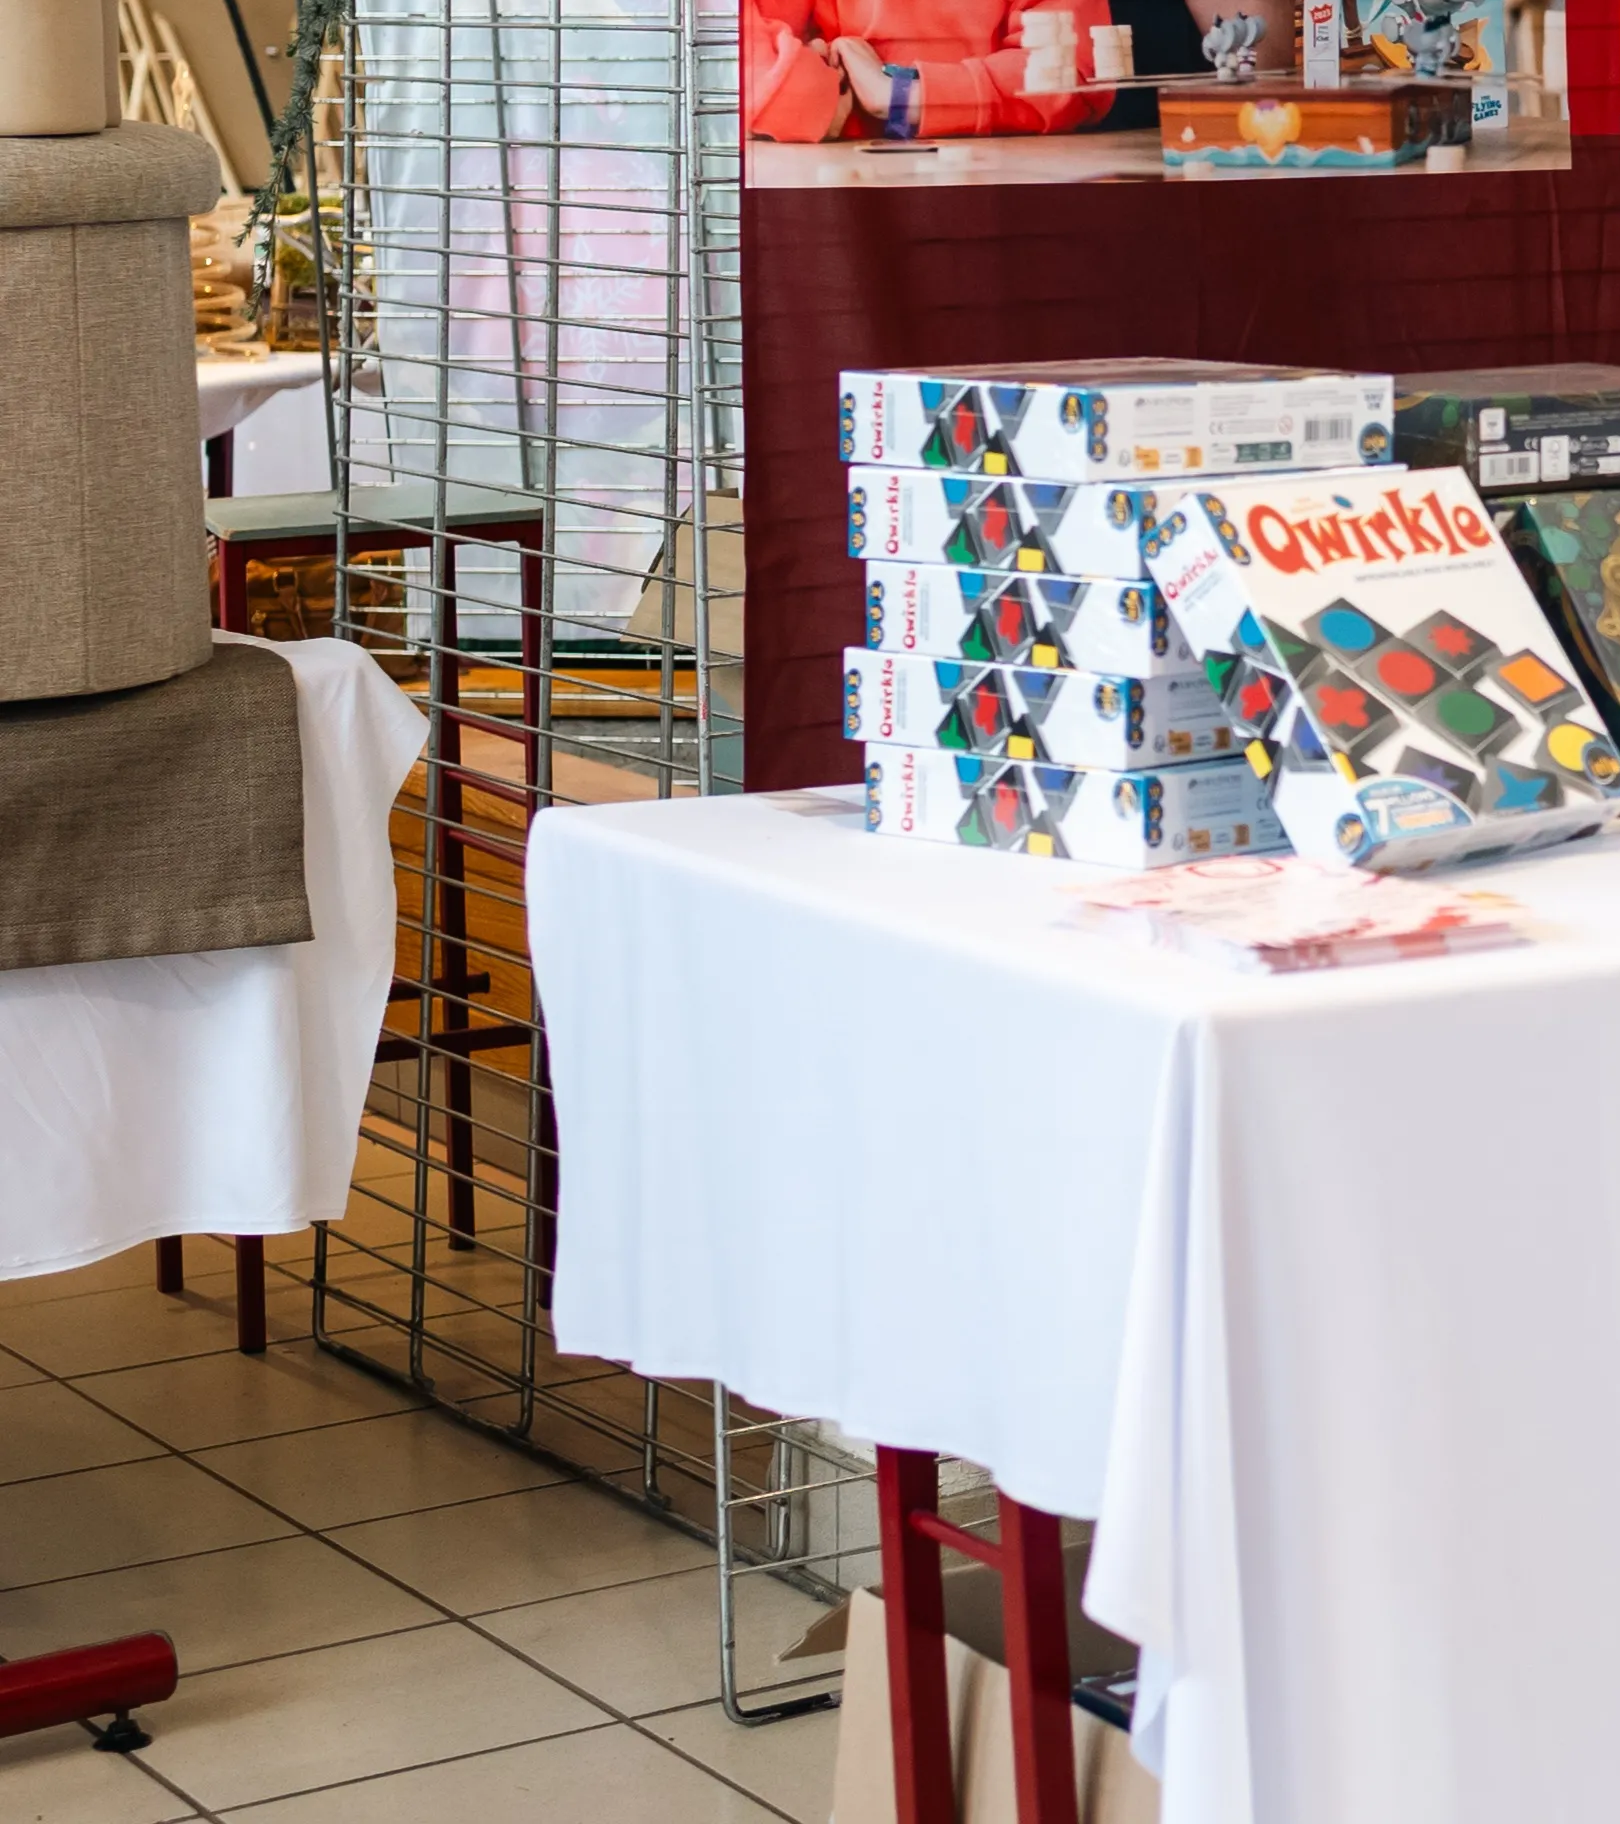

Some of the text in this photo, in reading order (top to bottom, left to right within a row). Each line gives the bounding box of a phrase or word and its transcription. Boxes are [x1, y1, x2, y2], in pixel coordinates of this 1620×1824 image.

[870, 380, 884, 460] Qwirkle
[885, 475, 900, 555] Qwirkle
[1248, 489, 1496, 577] Qwirkle
[903, 569, 917, 649] Qwirkle
[879, 658, 894, 738] Qwirkle
[900, 752, 915, 832] Qwirkle
